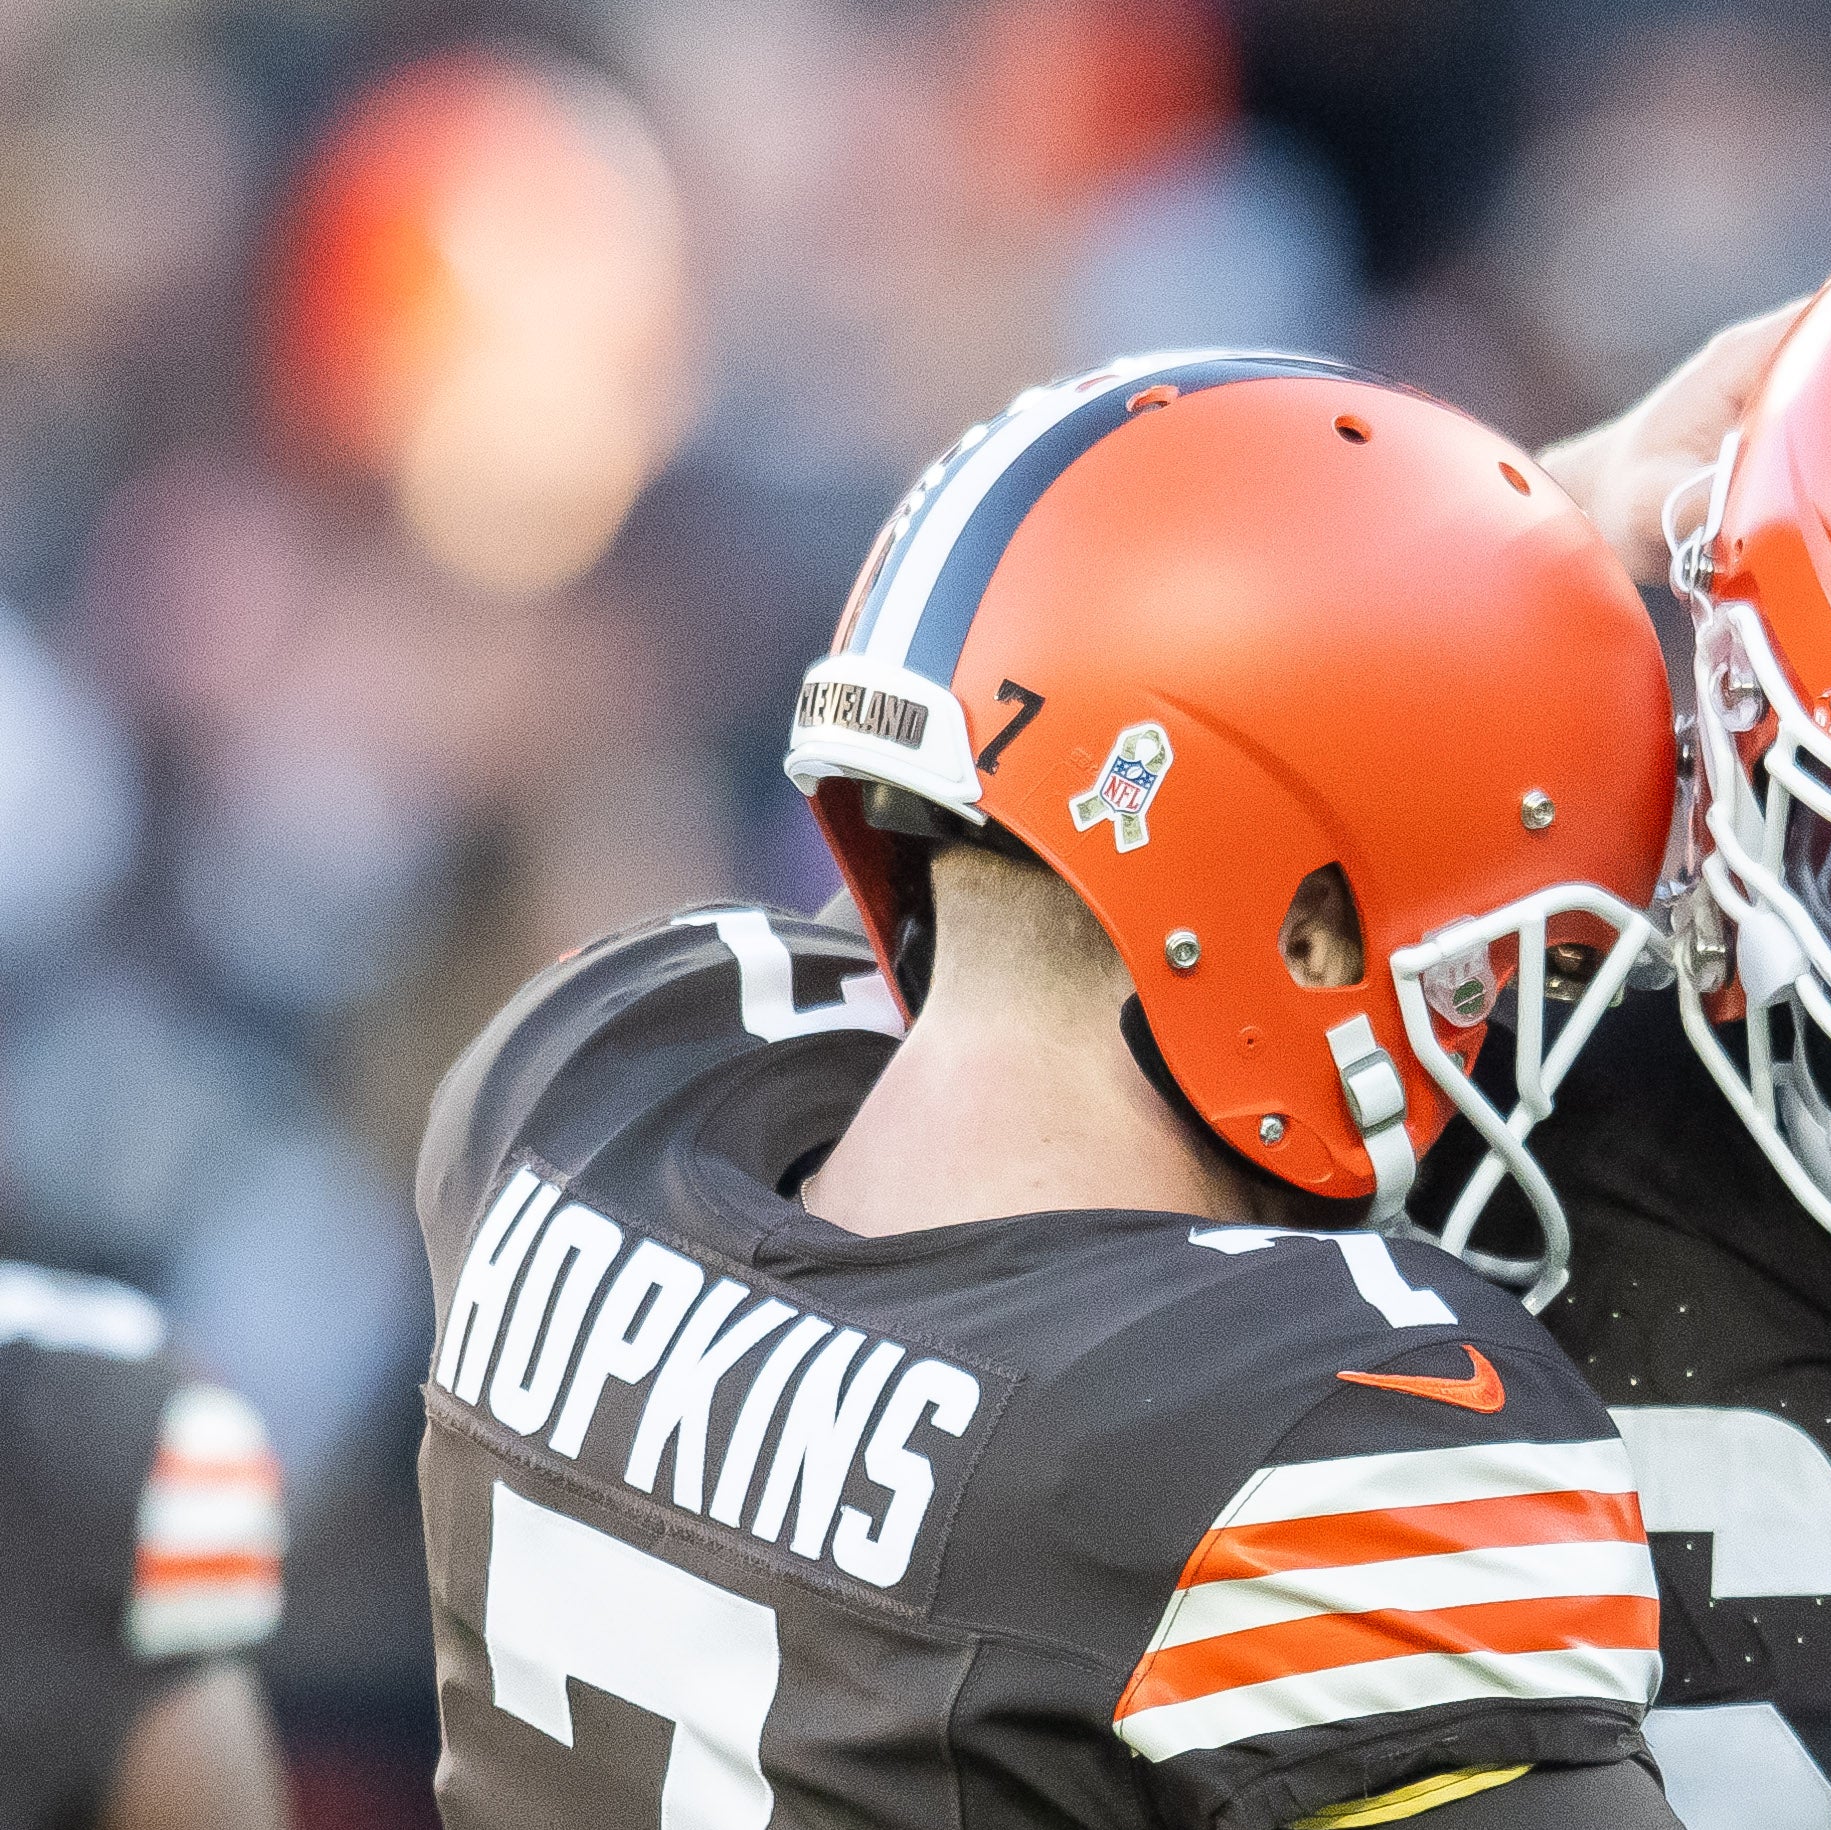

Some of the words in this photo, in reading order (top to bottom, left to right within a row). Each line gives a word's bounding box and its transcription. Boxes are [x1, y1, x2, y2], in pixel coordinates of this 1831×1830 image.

[798, 682, 929, 750] CLEVELAND
[976, 678, 1046, 776] 7
[1103, 775, 1141, 811] NFL
[434, 1166, 982, 1590] HOPKINS
